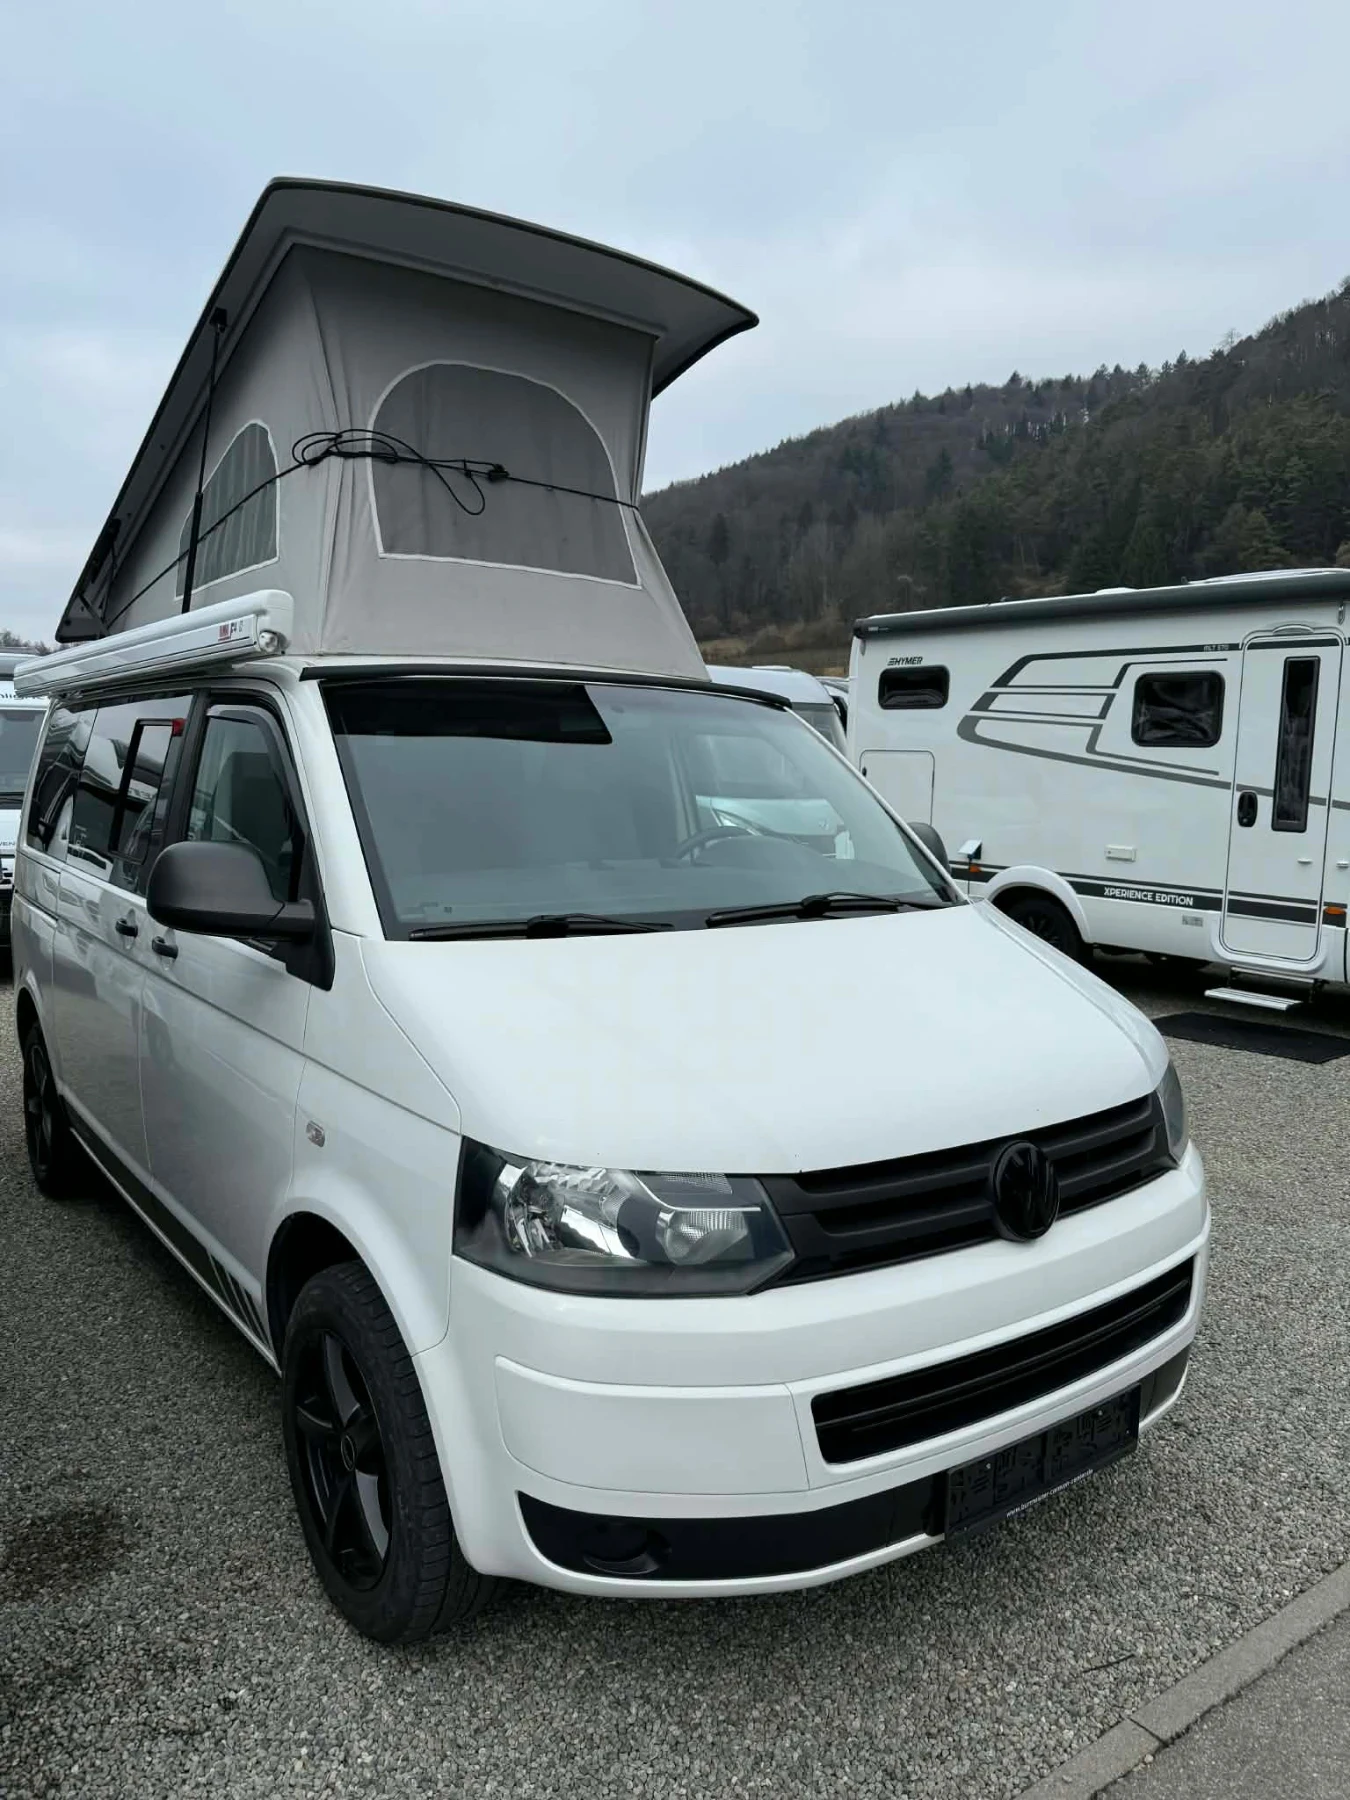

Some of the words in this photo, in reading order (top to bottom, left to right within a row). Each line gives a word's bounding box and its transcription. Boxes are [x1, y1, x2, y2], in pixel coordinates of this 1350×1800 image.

[887, 656, 923, 666] HYMER
[1103, 887, 1154, 901] XPERIENCE
[1155, 893, 1194, 906] EDITION
